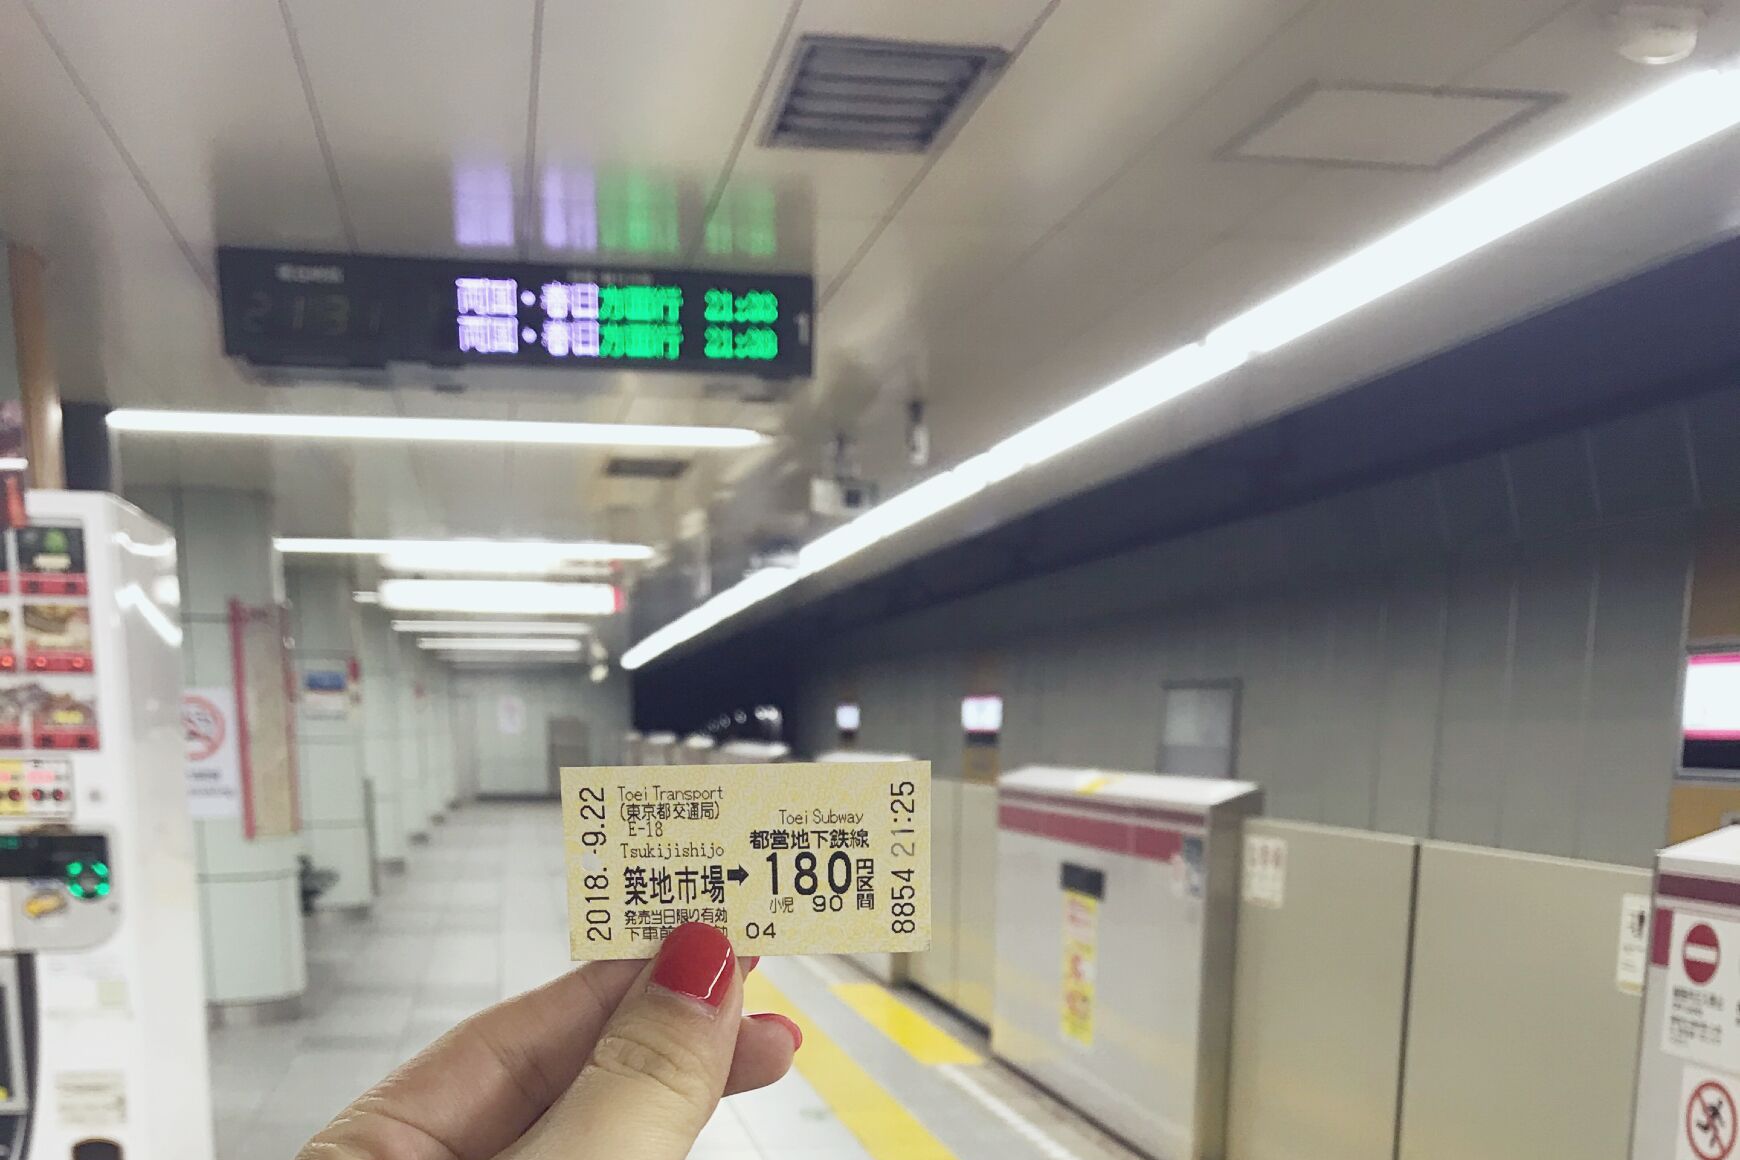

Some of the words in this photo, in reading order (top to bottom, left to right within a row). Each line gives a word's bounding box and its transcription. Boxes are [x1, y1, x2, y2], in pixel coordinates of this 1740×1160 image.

[616, 785, 648, 802] Toei
[651, 784, 724, 802] Transport
[778, 809, 808, 825] Toei
[812, 808, 864, 825] Subway
[890, 781, 915, 857] 21:25
[627, 821, 664, 838] E-18
[749, 828, 870, 851] 都営地下鉄線
[619, 841, 725, 861] Tsukijishijo
[765, 850, 853, 897] 180
[622, 864, 726, 906] 築地市場
[855, 858, 875, 911] 円区間
[769, 896, 794, 914] 小児
[812, 894, 844, 913] 90
[890, 868, 916, 934] 8854
[622, 908, 728, 925] 発売当日限り有効
[745, 921, 777, 940] 04
